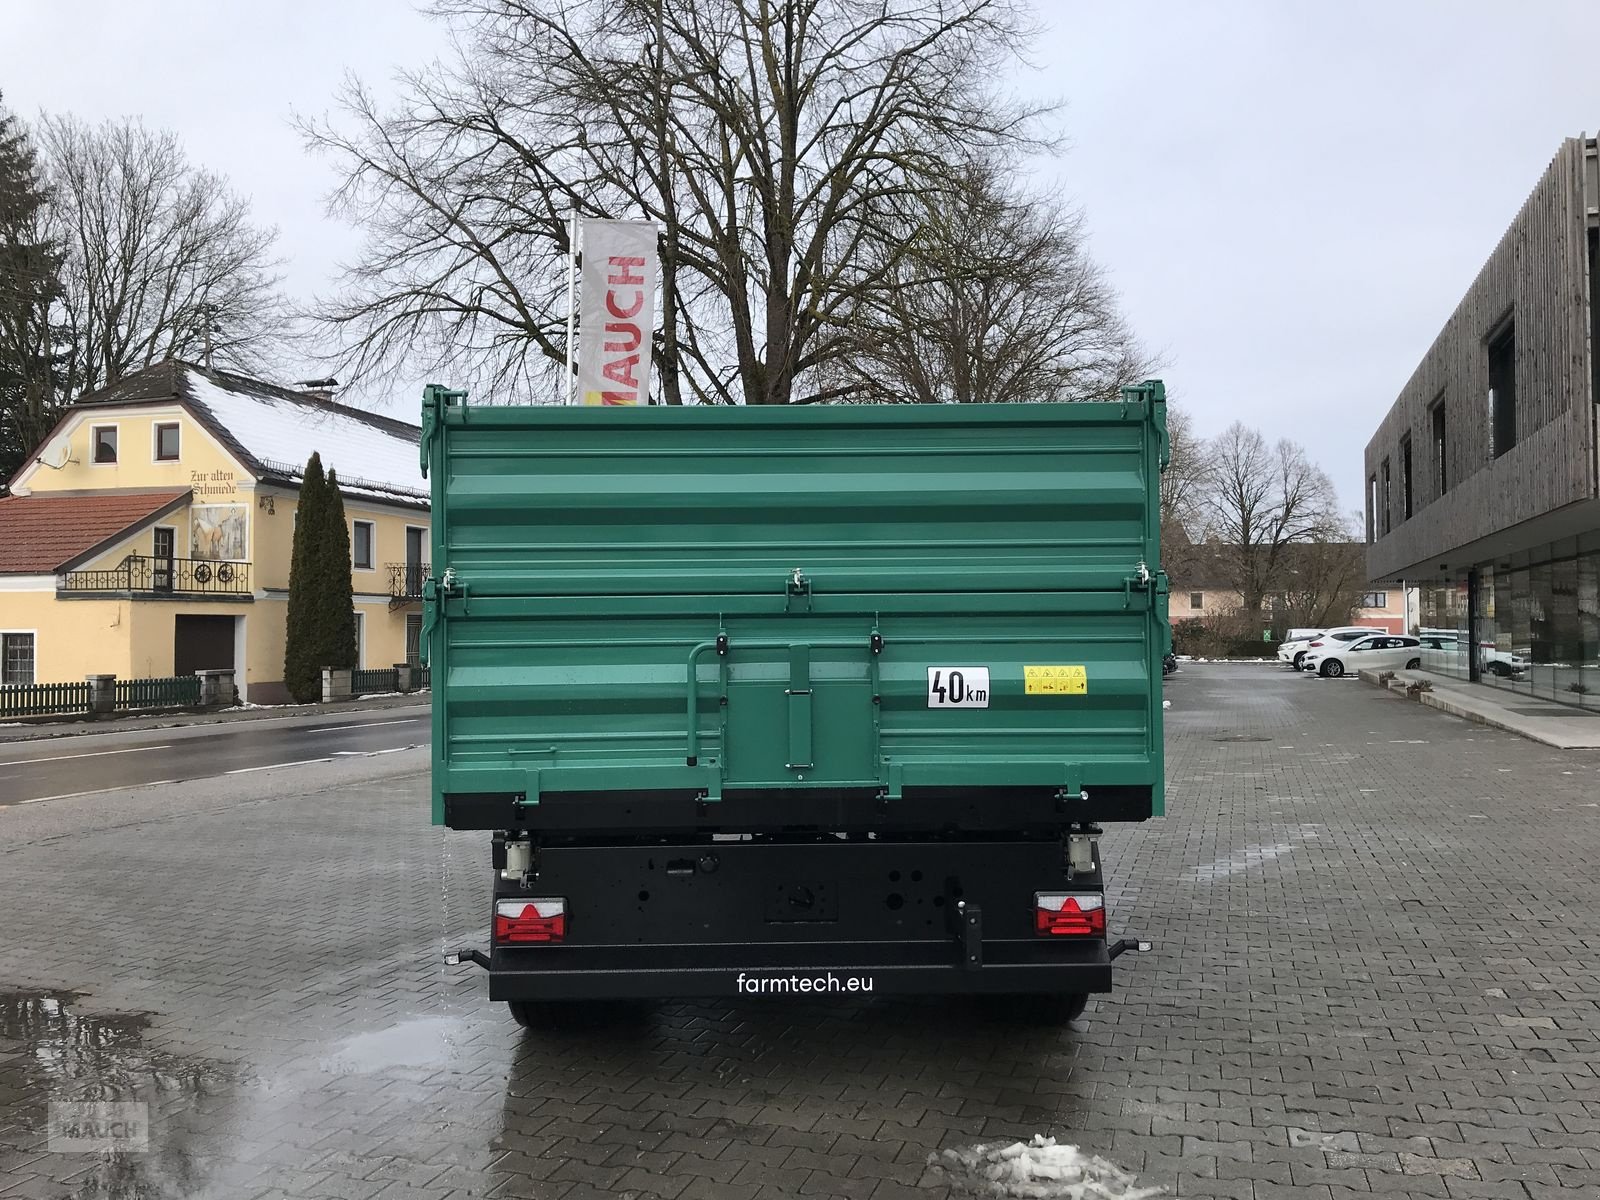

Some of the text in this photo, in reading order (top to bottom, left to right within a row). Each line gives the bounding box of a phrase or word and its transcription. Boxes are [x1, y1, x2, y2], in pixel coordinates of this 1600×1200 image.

[190, 469, 233, 481] Zur alten
[192, 482, 237, 496] Schmiede
[736, 972, 873, 993] farmtech.eu
